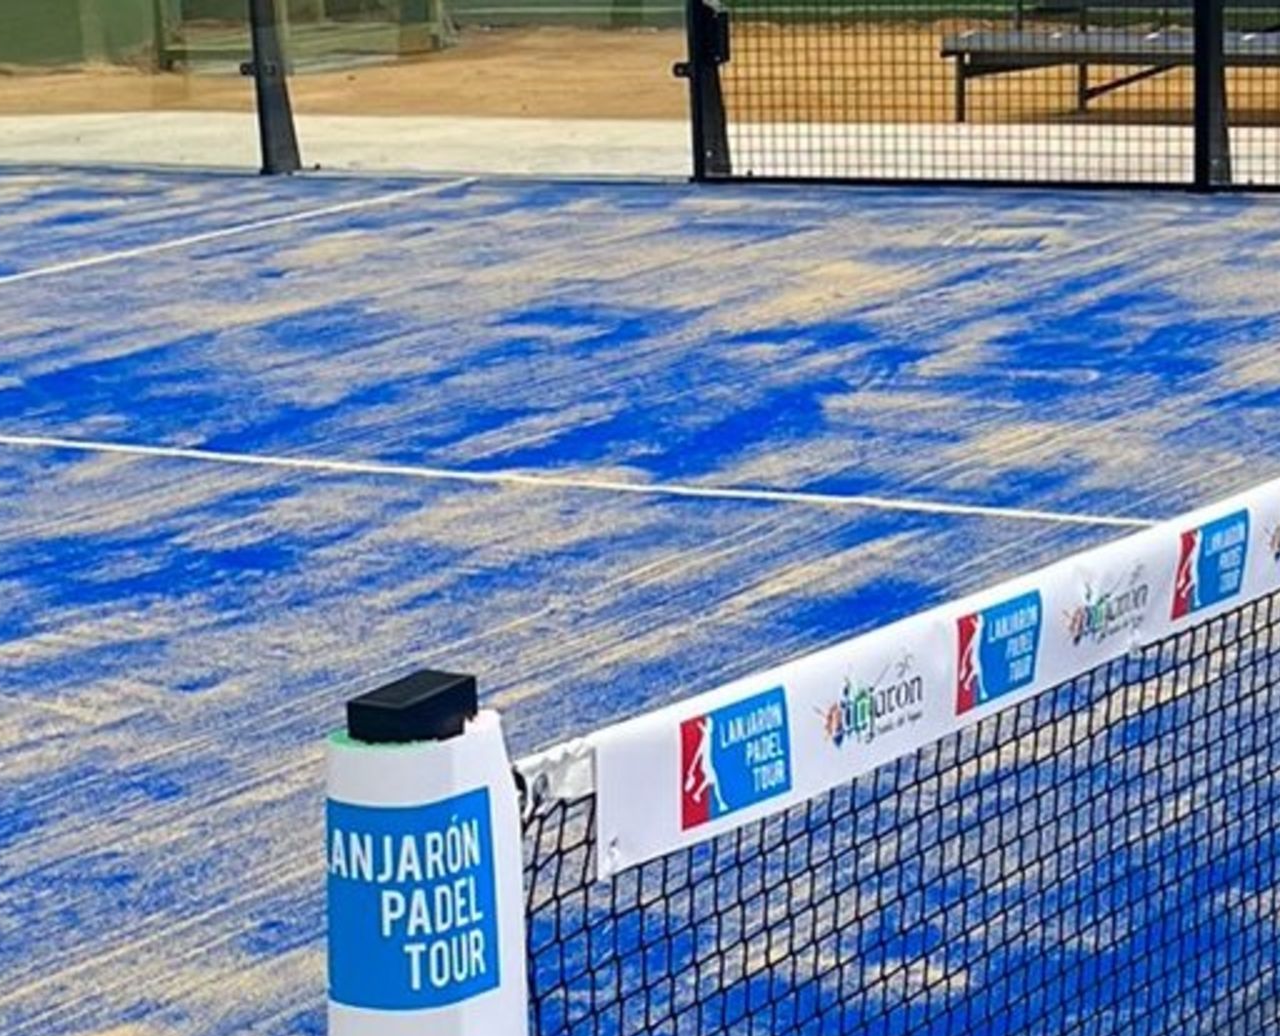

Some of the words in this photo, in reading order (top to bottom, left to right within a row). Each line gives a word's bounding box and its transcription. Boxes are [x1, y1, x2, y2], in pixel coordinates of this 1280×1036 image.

[327, 814, 480, 883] ANJARÓN
[381, 875, 484, 936] PADEL
[403, 929, 486, 992] TOUR
